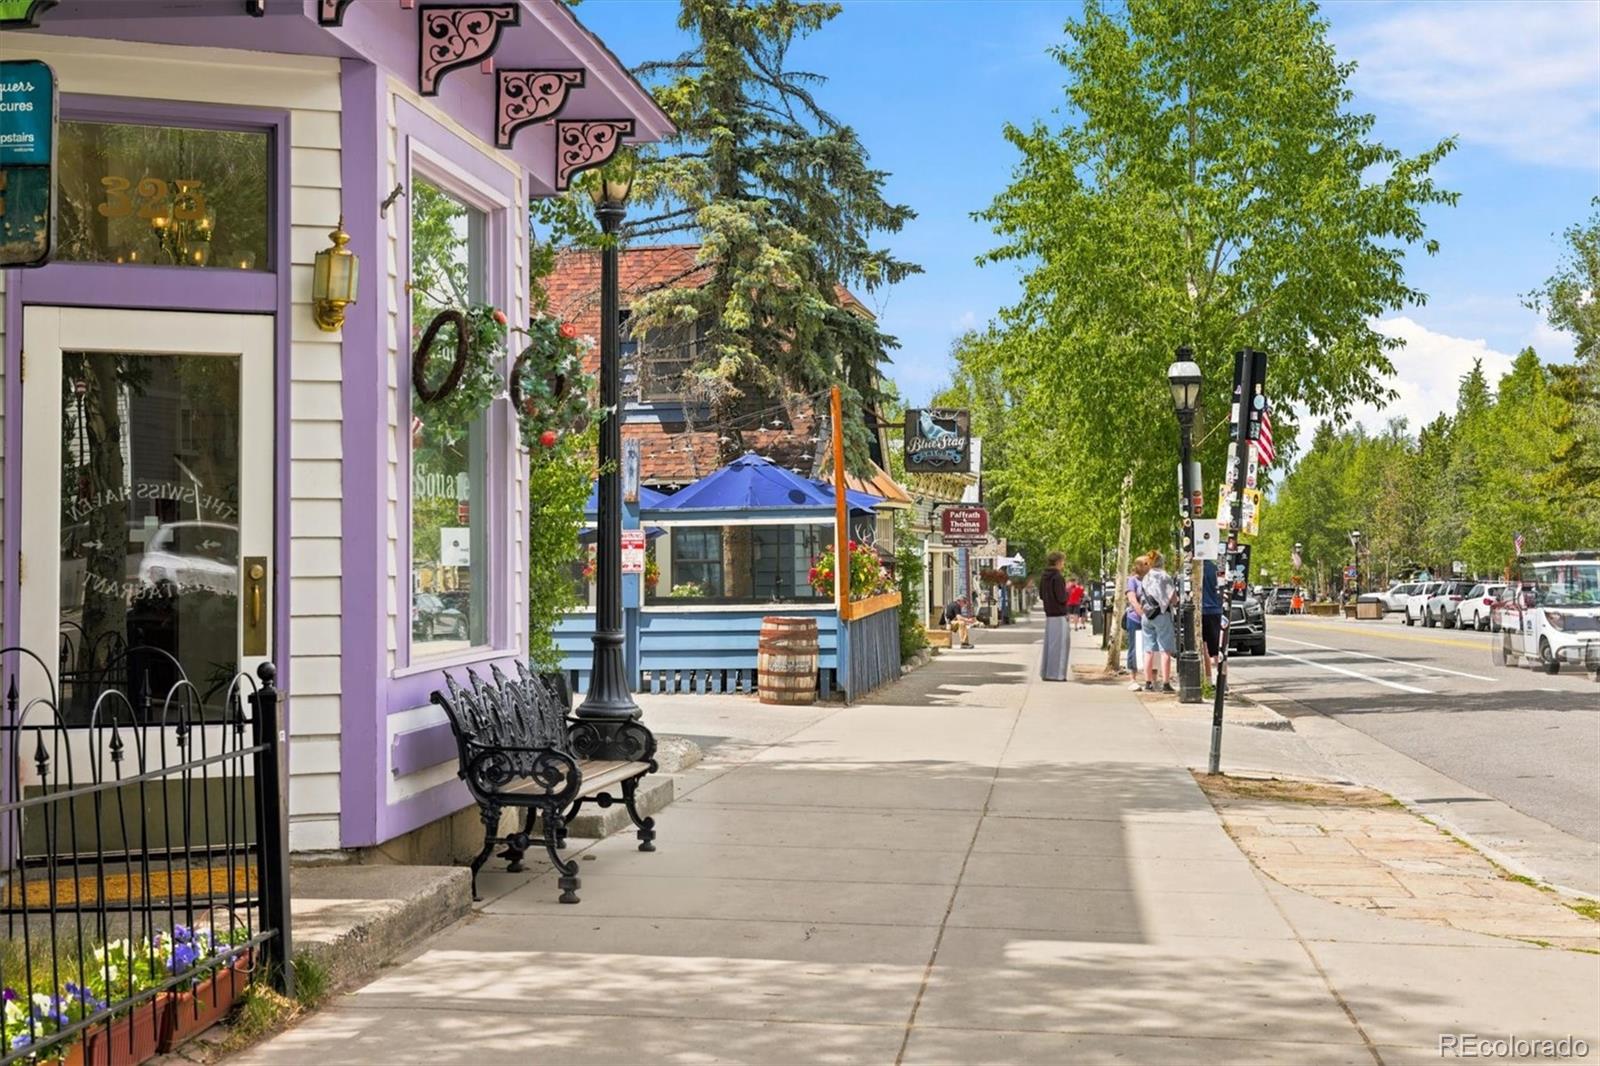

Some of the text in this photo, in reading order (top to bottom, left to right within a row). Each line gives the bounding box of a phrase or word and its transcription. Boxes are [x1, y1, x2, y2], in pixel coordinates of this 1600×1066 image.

[98, 176, 205, 219] 325
[907, 435, 966, 453] Blue Stag
[415, 463, 470, 503] Square
